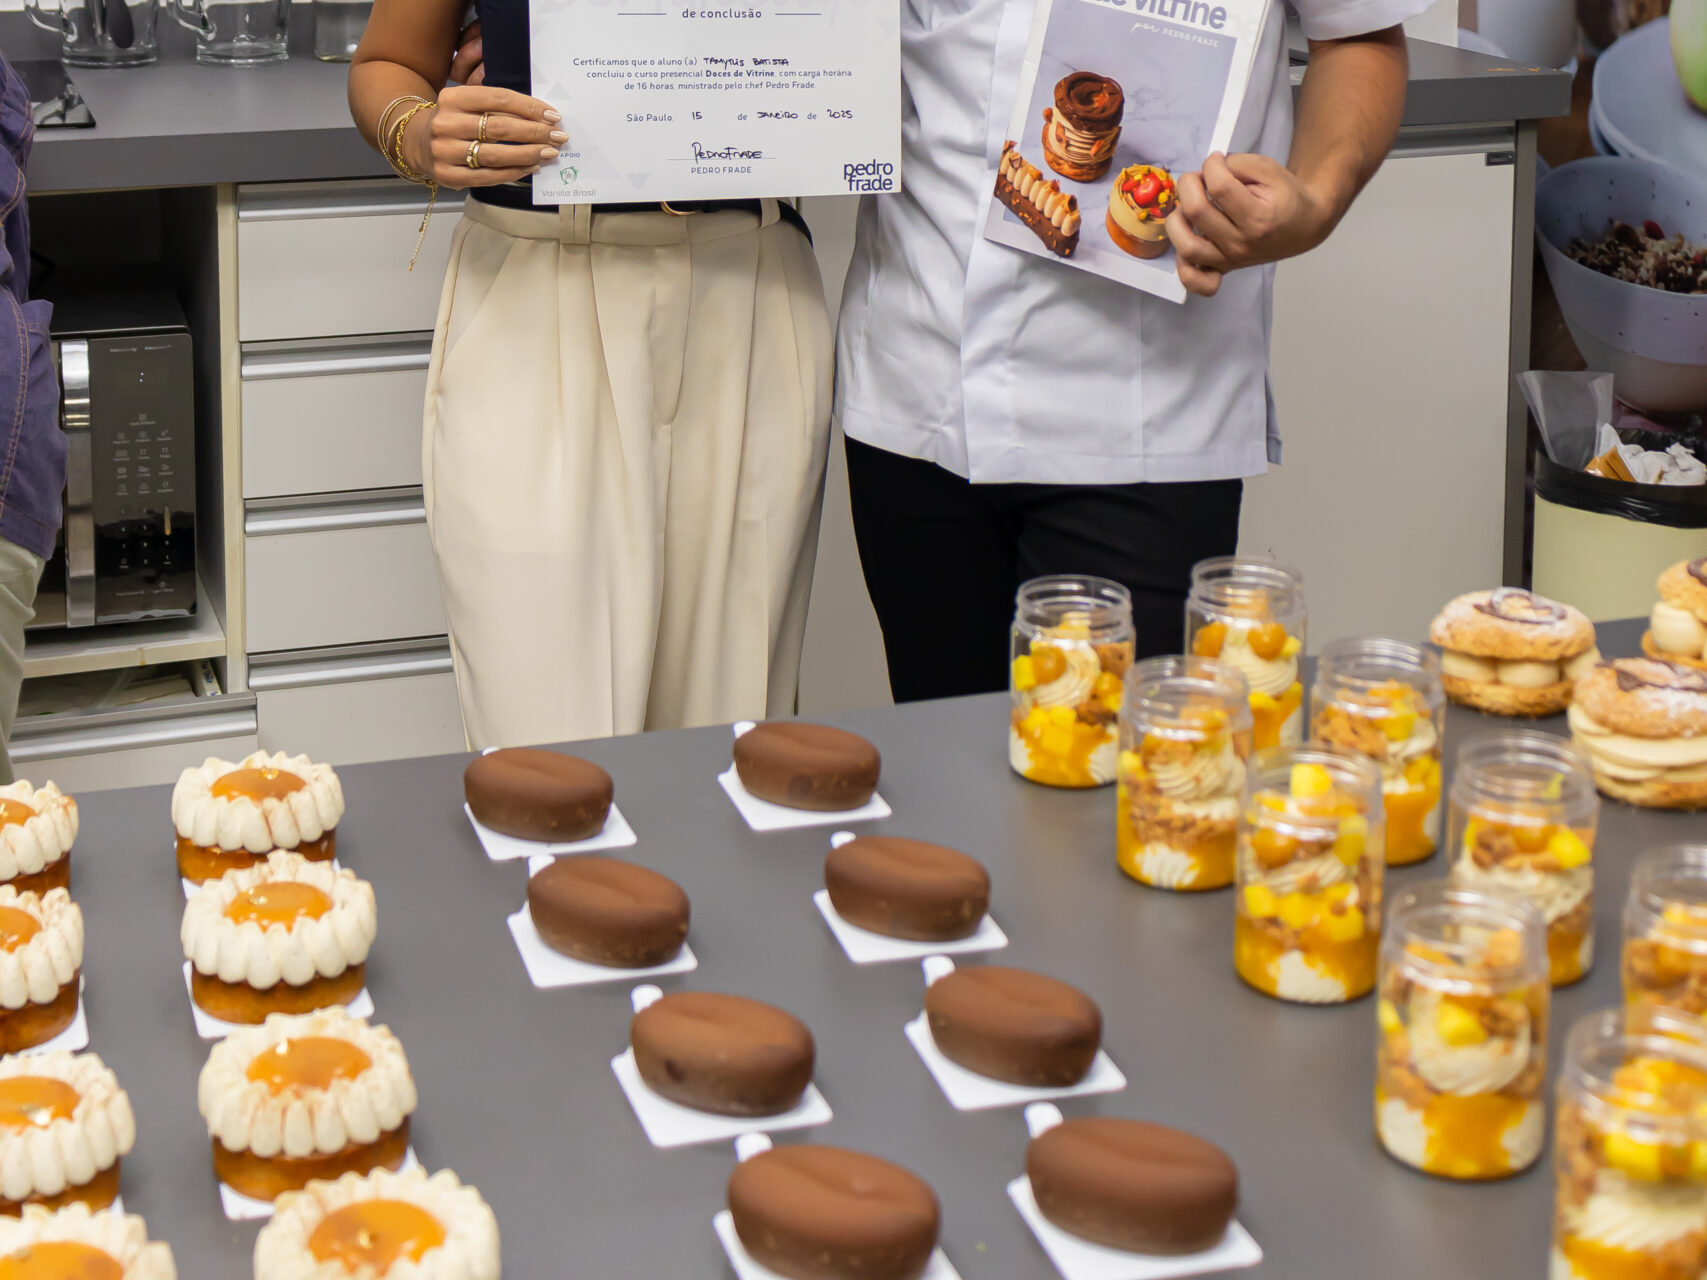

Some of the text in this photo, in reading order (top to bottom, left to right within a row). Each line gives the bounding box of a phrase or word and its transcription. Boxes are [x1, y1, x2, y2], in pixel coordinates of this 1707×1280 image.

[682, 8, 762, 19] de conclusão
[1162, 27, 1191, 41] PEDRO
[1192, 34, 1220, 48] FRADE
[573, 57, 630, 66] Certificamos
[631, 59, 648, 68] que
[657, 57, 683, 66] aluno
[684, 56, 698, 67] (a)
[586, 70, 625, 78] concluiu
[660, 70, 703, 81] presencial
[705, 69, 732, 78] Doces
[733, 69, 744, 78] de
[798, 71, 821, 79] carga
[822, 68, 852, 77] horária
[624, 81, 817, 91] de 16 horas, ministrado pelo chef Pedro Frade.
[626, 113, 675, 123] São Paulo,
[691, 111, 703, 120] 15
[737, 112, 748, 121] de
[806, 112, 817, 120] de
[826, 108, 853, 119] 2025
[691, 166, 752, 174] PEDRO FRADE
[843, 158, 894, 180] pedro
[847, 174, 893, 192] frade
[541, 189, 597, 198] Vanilla Brasil
